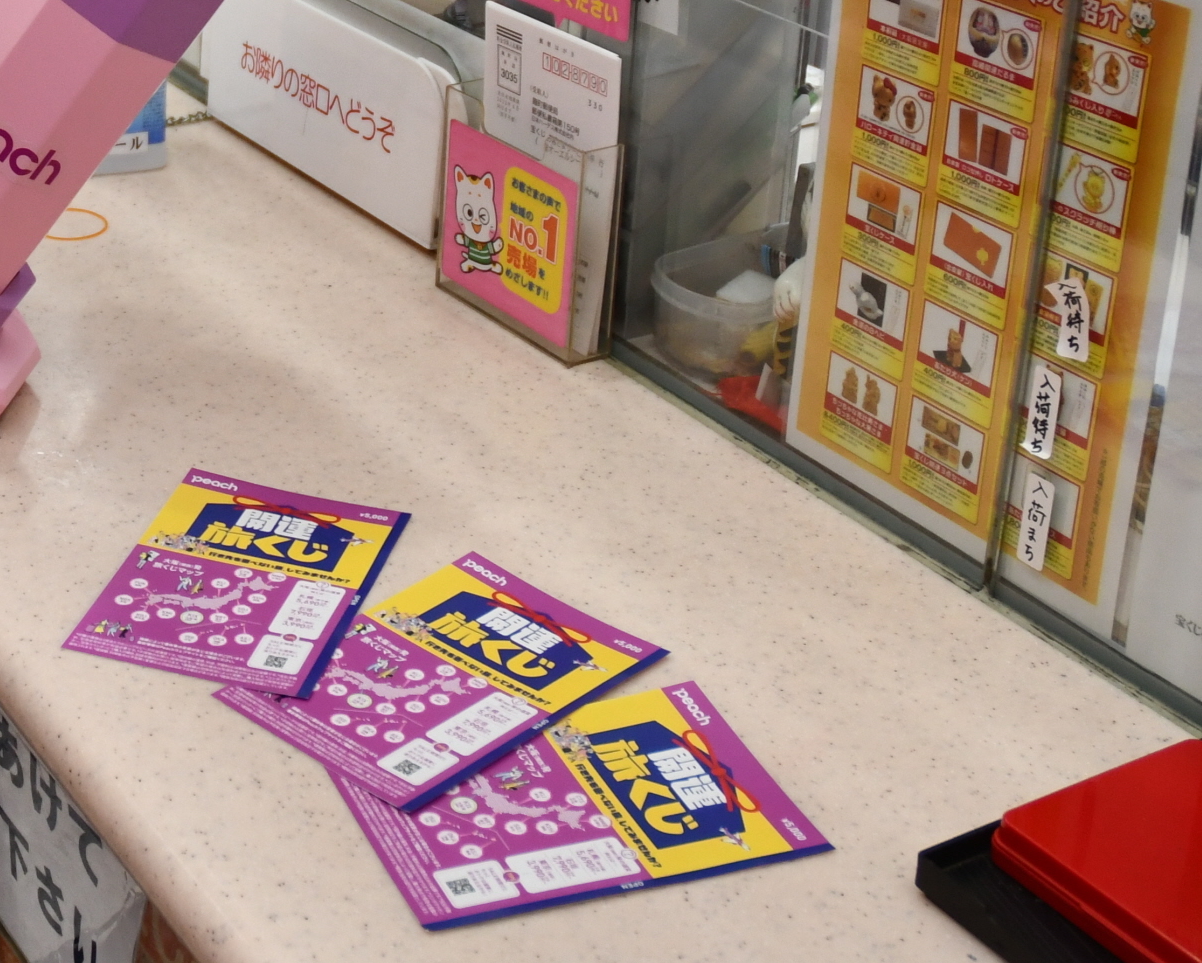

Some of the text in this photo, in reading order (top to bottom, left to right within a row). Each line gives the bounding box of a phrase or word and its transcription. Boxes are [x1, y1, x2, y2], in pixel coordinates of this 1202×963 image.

[240, 39, 396, 154] お隣りの窓口へどうぞ
[500, 68, 518, 84] 3035
[510, 201, 534, 222] 地域の
[512, 177, 561, 212] お客さまの声で
[509, 213, 559, 265] NO.1
[1058, 282, 1085, 353] 入荷待ち
[1030, 374, 1056, 454] 入荷待ち
[191, 474, 238, 492] peach
[200, 520, 328, 564] 旅くじ
[236, 508, 319, 541] 開運
[1024, 481, 1049, 562] 入荷まち
[153, 562, 204, 577] 旅くじマップ
[463, 558, 507, 587] peach
[360, 637, 407, 663] 旅くじマップ
[428, 611, 555, 678] 旅くじ
[475, 606, 563, 655] 開運
[672, 688, 711, 727] peach
[591, 739, 699, 835] 旅くじ
[648, 746, 728, 811] 開運
